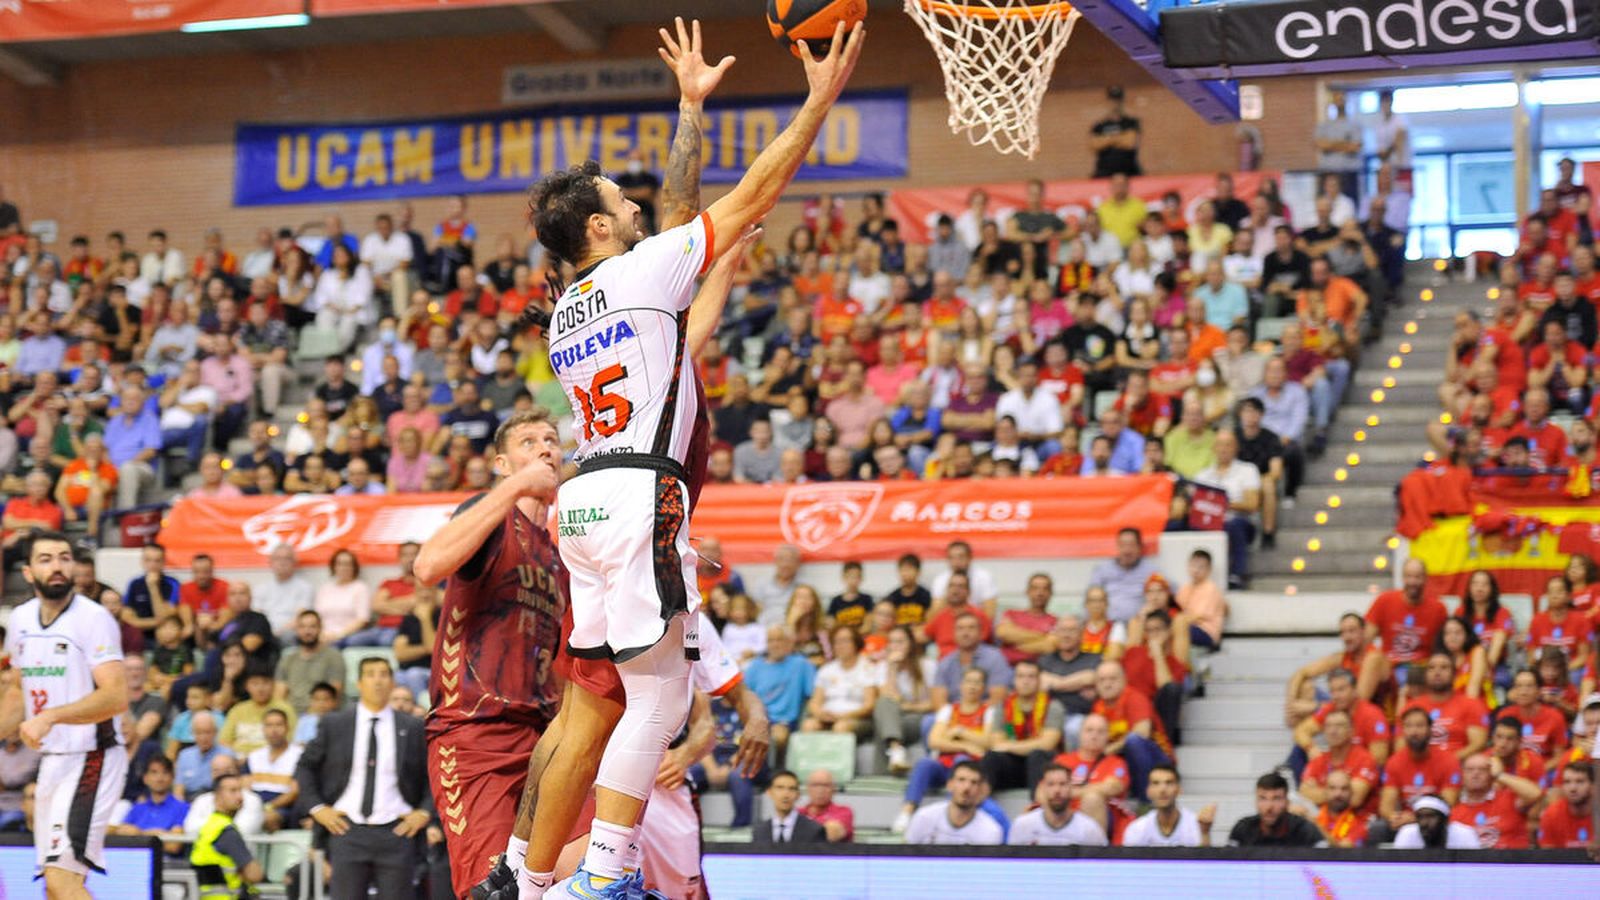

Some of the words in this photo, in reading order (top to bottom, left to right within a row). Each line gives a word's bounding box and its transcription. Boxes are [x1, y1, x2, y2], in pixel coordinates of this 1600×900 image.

[1274, 0, 1577, 59] endesa
[275, 128, 435, 192] UCAM
[458, 104, 861, 182] UNIVERIDD
[556, 288, 608, 335] COSTA
[550, 319, 636, 375] PULEVA
[572, 362, 634, 442] 15
